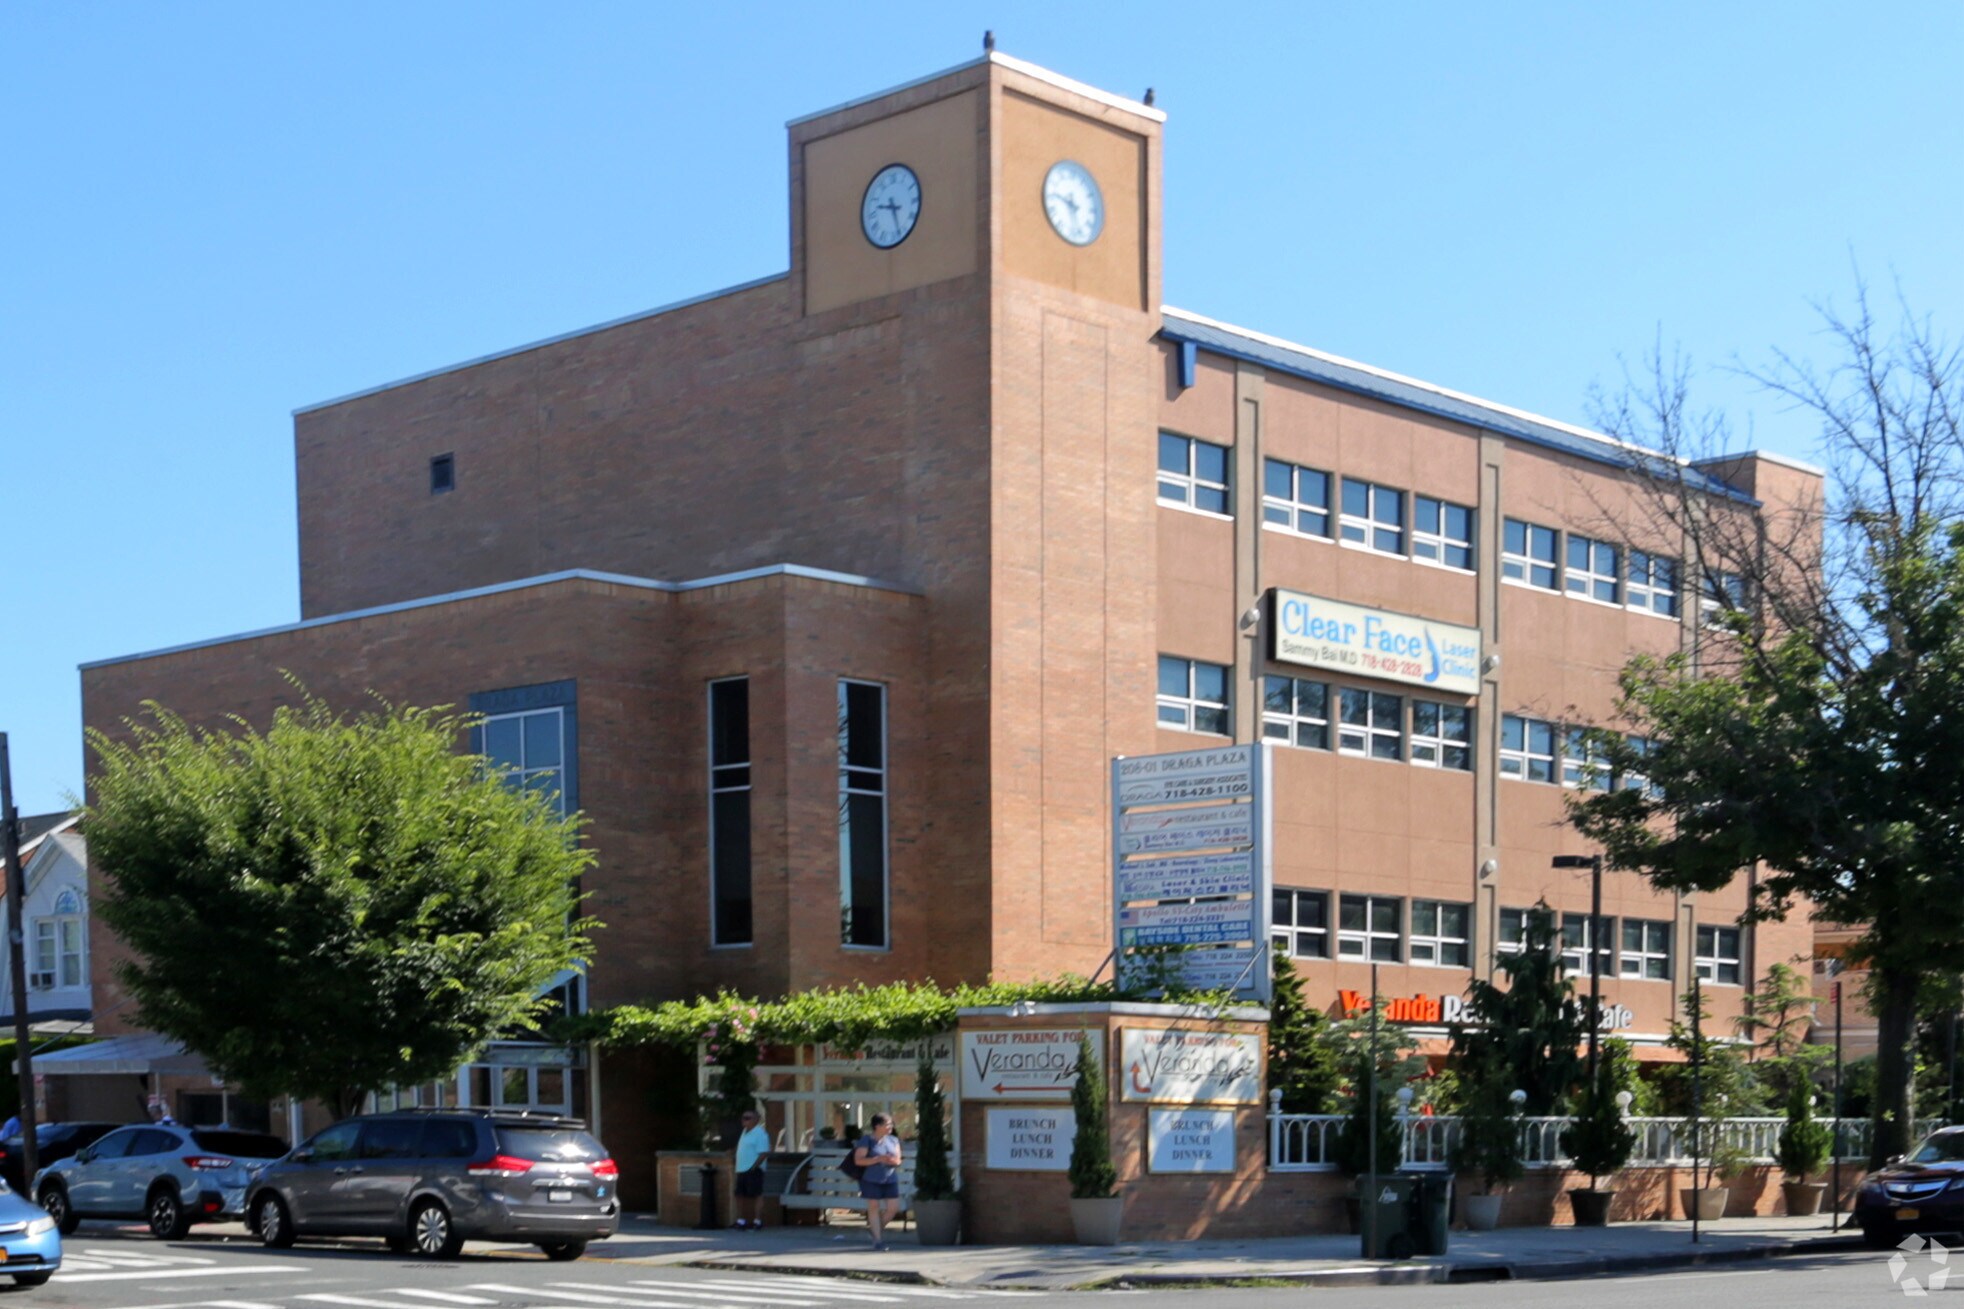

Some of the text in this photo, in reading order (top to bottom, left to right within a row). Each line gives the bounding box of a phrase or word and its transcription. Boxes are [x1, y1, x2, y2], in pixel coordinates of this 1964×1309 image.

[1282, 600, 1422, 658] Clear Face
[1282, 639, 1319, 662] Sammy
[1442, 638, 1476, 659] Laser
[1442, 658, 1476, 680] Clinic
[1162, 757, 1203, 772] DRAGA
[1206, 751, 1246, 767] PLAZA
[1164, 783, 1248, 799] 718-428-1100
[1162, 879, 1187, 887] Laser
[1223, 874, 1250, 883] Clinic
[1181, 923, 1219, 934] DENTAL
[1221, 921, 1249, 931] CARE
[1338, 989, 1440, 1023] Veanda
[976, 1032, 1008, 1045] VALET
[1011, 1032, 1059, 1045] PARKING
[971, 1047, 1065, 1083] Veranda
[1141, 1048, 1229, 1084] Veranda
[1008, 1119, 1056, 1130] BRUNCH
[1170, 1120, 1214, 1131] BRUNCH
[1012, 1134, 1053, 1145] LUNCH
[1174, 1134, 1211, 1146] LUNCH
[1010, 1148, 1054, 1160] DINNER
[1171, 1149, 1213, 1161] DINNER
